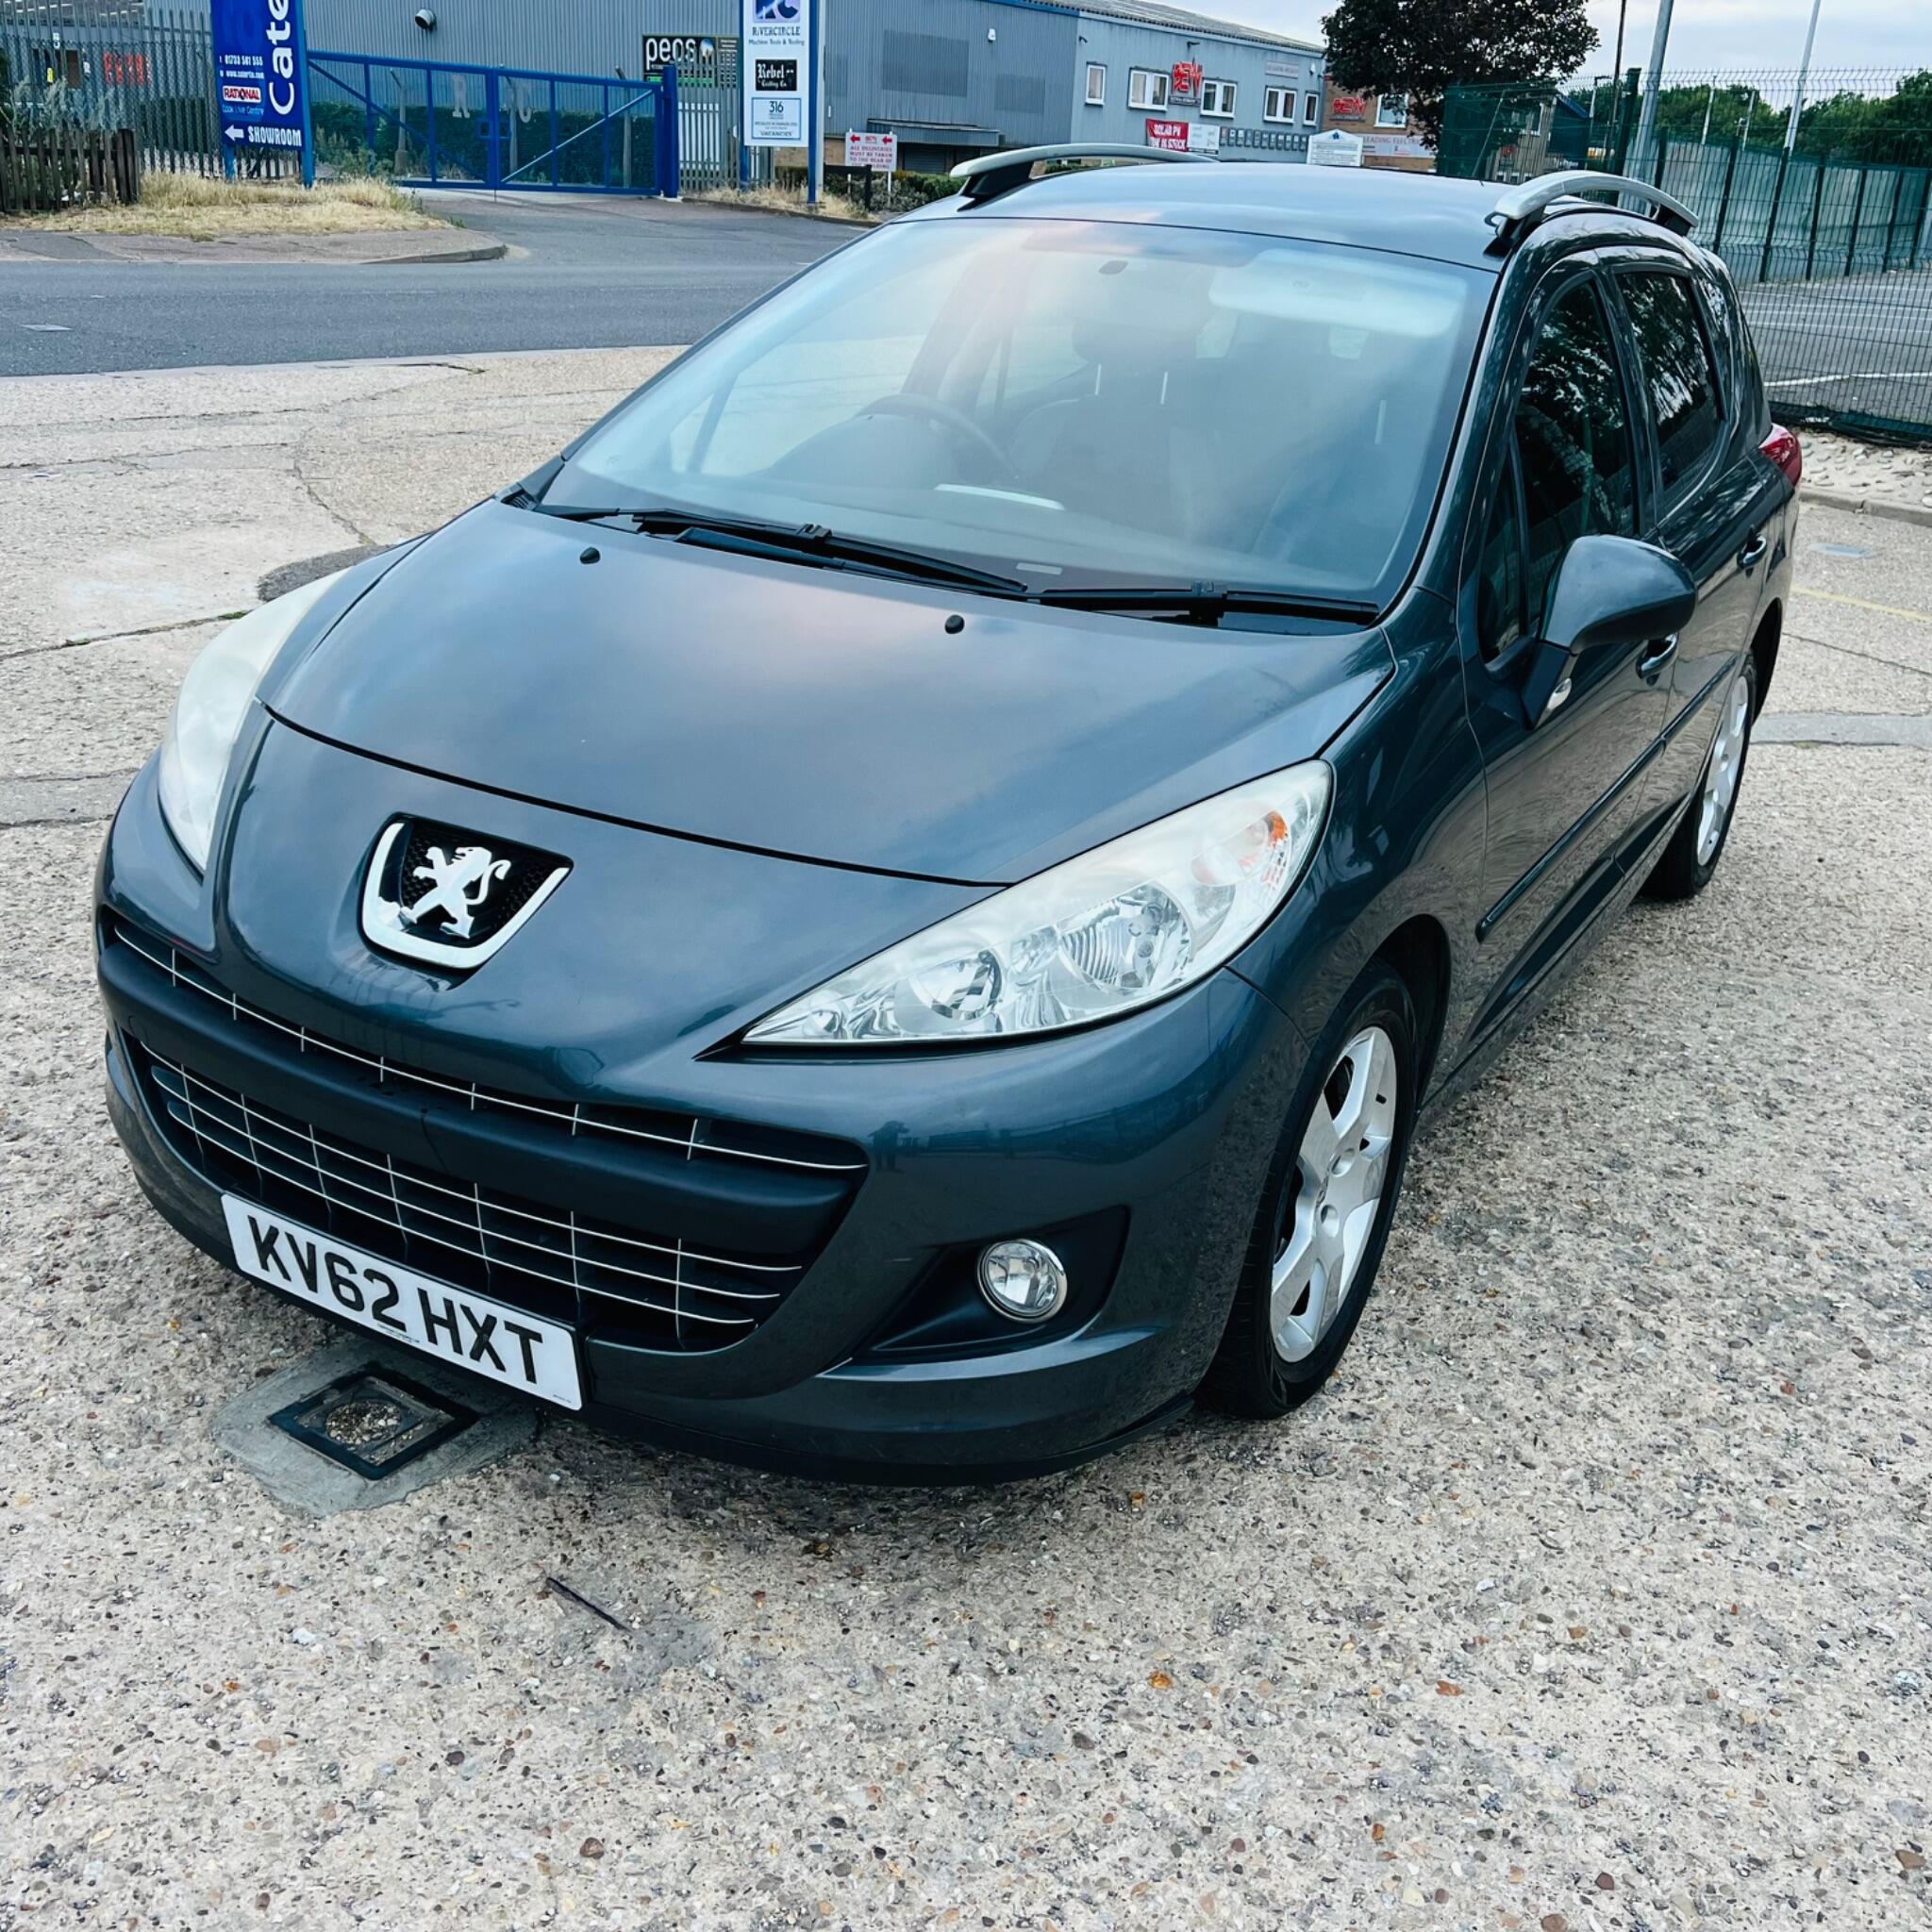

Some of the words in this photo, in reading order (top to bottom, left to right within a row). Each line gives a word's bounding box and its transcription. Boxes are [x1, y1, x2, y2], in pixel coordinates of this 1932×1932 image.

[758, 63, 785, 79] Rebel
[224, 88, 259, 100] RATIONAL
[769, 100, 784, 113] 316
[247, 125, 302, 147] SHOWROOM
[247, 1214, 407, 1333] KV62
[417, 1287, 543, 1385] HXT
